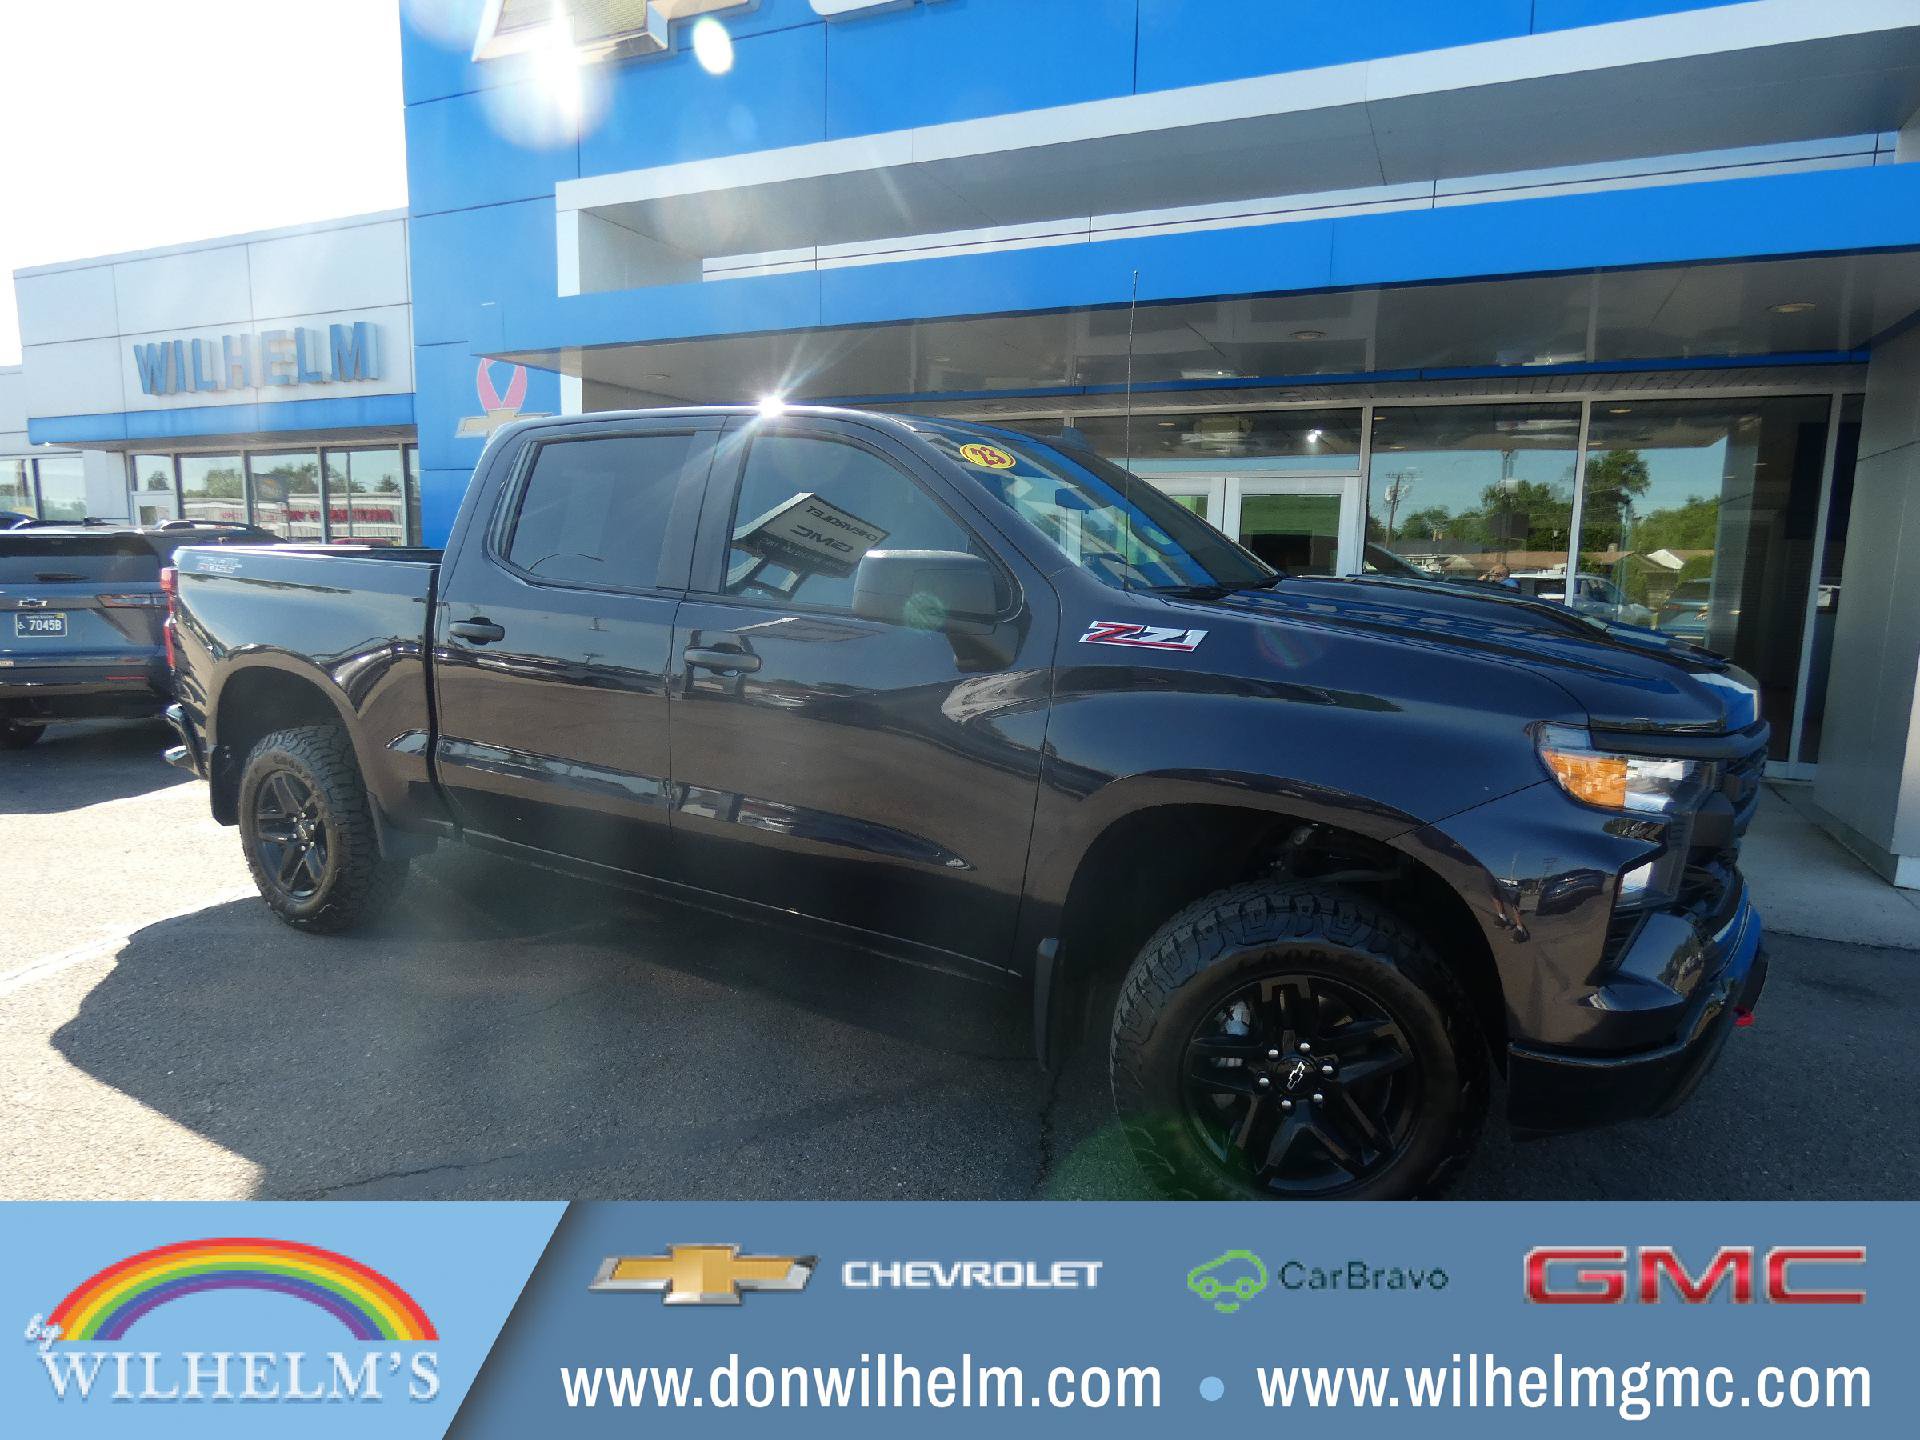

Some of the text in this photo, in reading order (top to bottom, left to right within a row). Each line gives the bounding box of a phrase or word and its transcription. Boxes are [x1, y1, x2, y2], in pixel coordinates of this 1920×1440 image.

[133, 321, 378, 396] WILHELM
[969, 446, 1007, 466] 23
[1078, 620, 1209, 652] Z71
